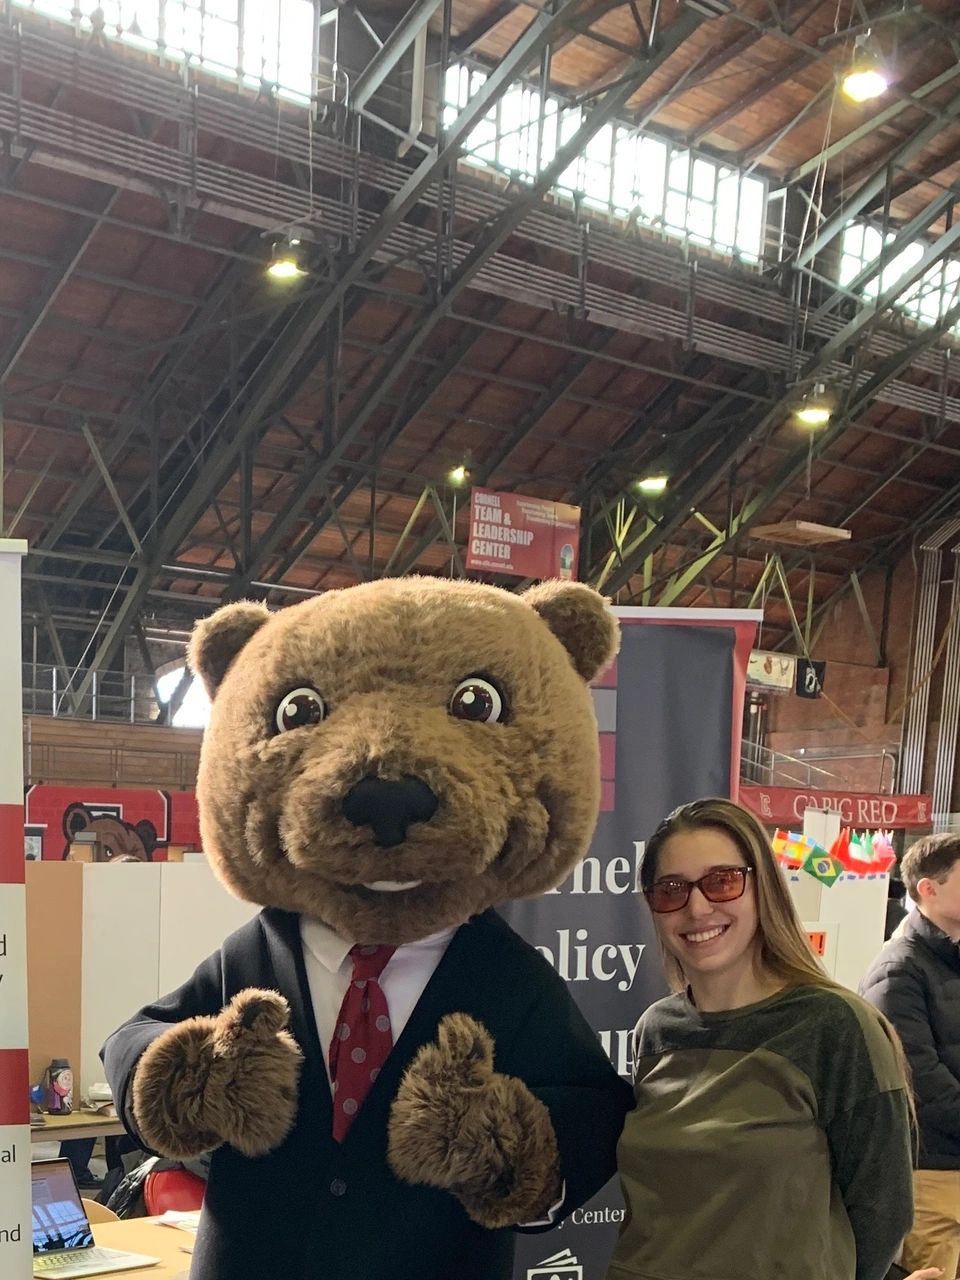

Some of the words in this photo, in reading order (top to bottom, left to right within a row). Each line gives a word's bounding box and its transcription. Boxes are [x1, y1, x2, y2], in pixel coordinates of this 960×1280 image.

[474, 505, 502, 523] TEAM
[503, 513, 512, 526] &
[472, 522, 534, 546] LEADERSHIP
[471, 540, 511, 560] CENTER
[858, 799, 897, 824] RED
